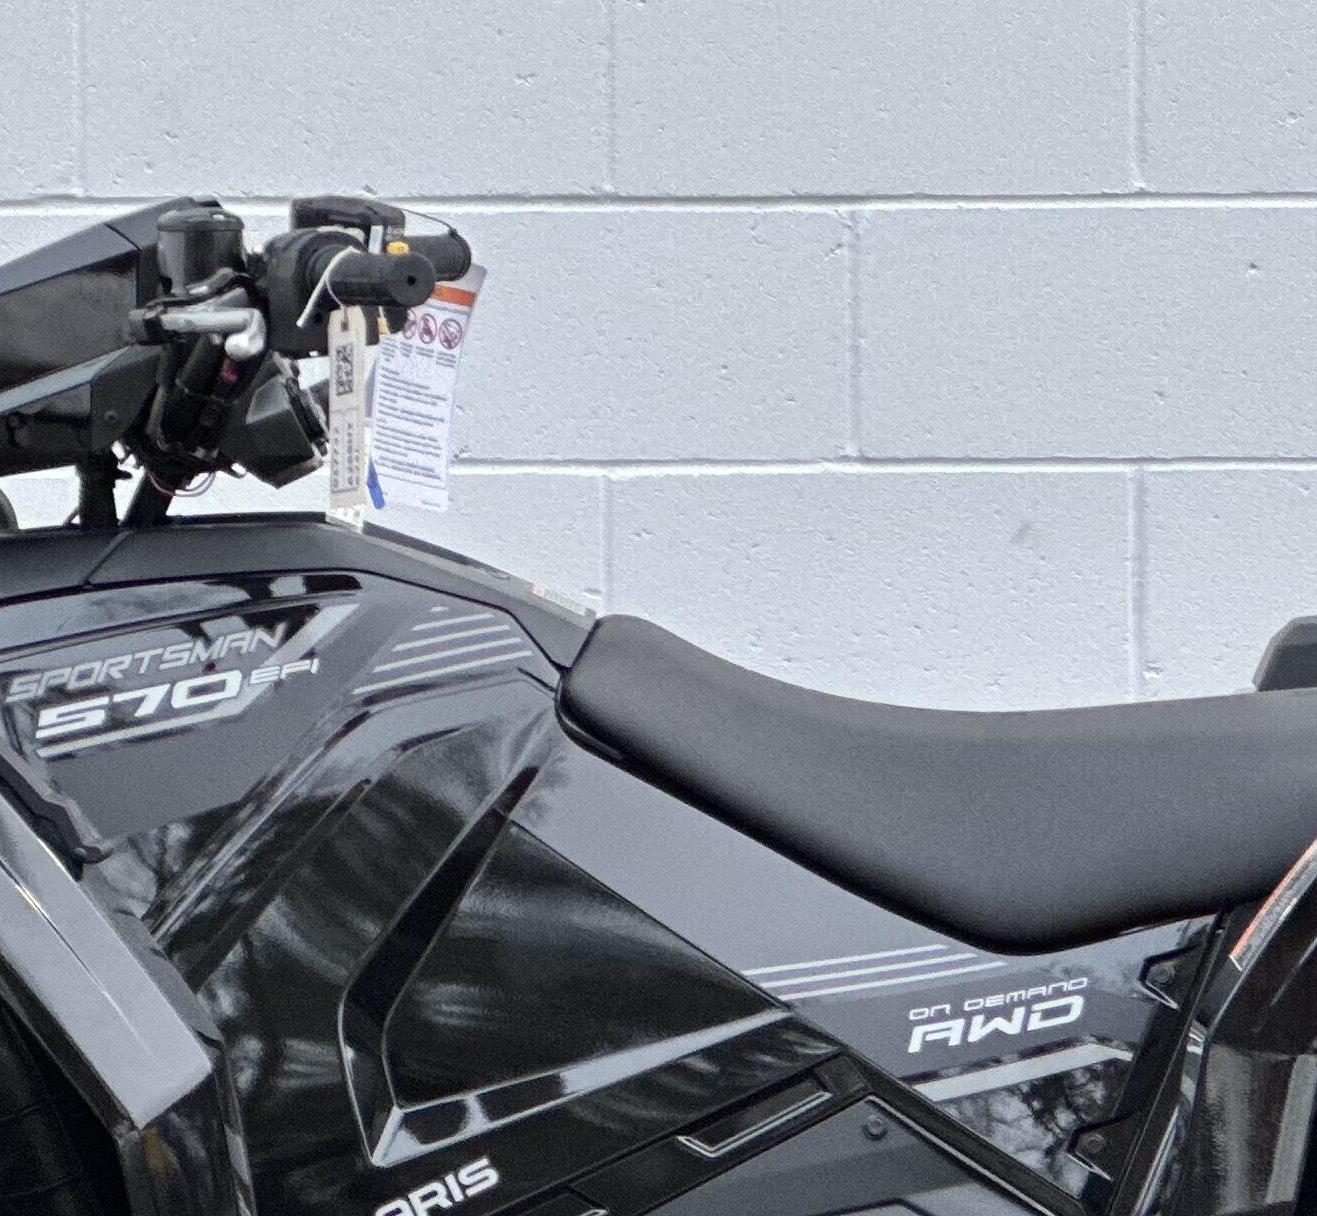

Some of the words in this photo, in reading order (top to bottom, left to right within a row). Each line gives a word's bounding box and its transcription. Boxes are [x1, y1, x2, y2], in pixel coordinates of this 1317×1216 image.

[5, 623, 286, 702] SPORTSMAN
[35, 670, 242, 738] 570
[249, 658, 319, 685] EFI
[907, 995, 1084, 1053] AWD
